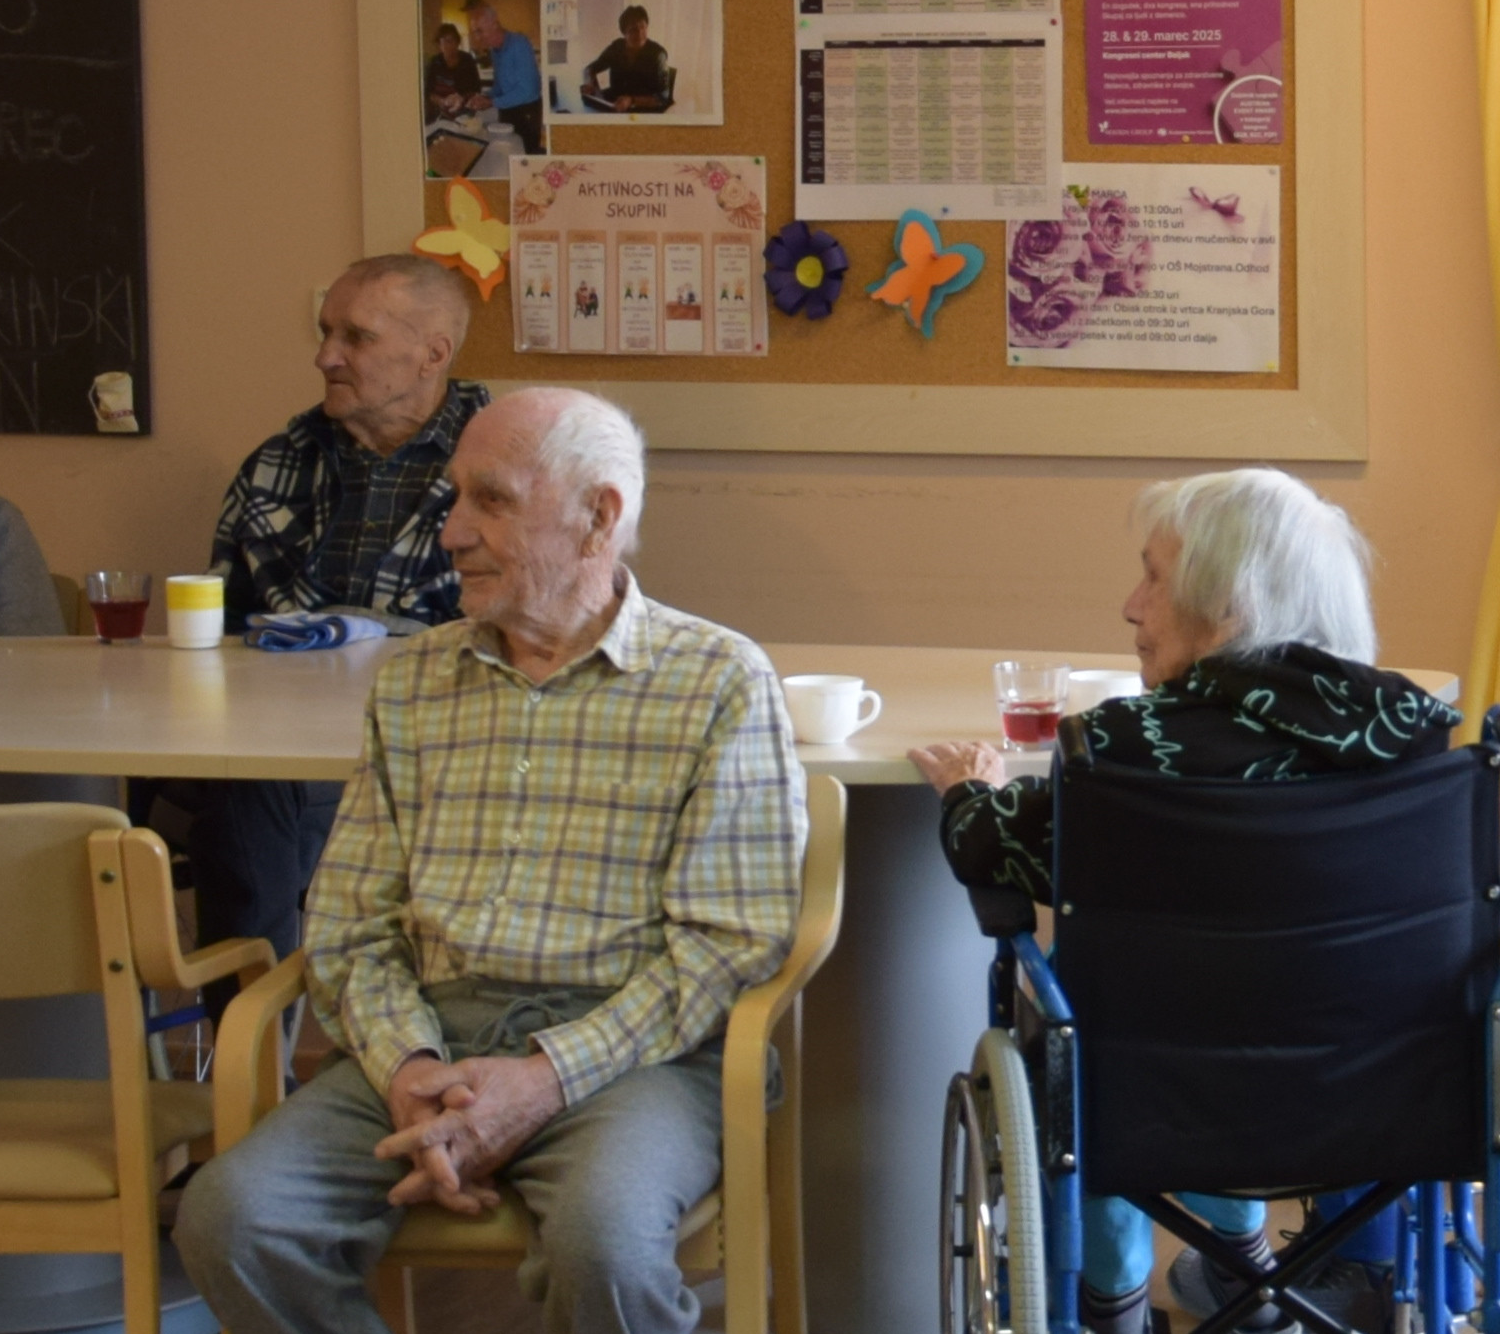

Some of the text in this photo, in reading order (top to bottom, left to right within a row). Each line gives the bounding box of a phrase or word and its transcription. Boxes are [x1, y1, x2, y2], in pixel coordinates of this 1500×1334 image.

[1102, 29, 1222, 43] 28. & 29. marec 2025
[577, 181, 695, 198] AKTIVNOSTI NA
[1091, 189, 1128, 199] MARCA
[605, 202, 667, 218] SKUPINI
[1143, 205, 1183, 215] 13:00uri
[1143, 219, 1169, 228] 10:15
[1171, 219, 1185, 229] uri
[1162, 234, 1193, 243] dnevu
[1195, 234, 1249, 244] mučenikov
[1167, 261, 1182, 271] OŠ
[1166, 290, 1180, 300] uri
[1113, 303, 1140, 313] Obisk
[1142, 305, 1167, 314] otrok
[1169, 305, 1178, 314] iz
[1179, 306, 1205, 314] vrtca
[1206, 305, 1249, 317] Kranjska
[1250, 306, 1275, 316] Gora
[1085, 318, 1131, 327] začetkom
[1133, 319, 1145, 327] ob
[1147, 318, 1175, 328] 09:30
[1177, 319, 1190, 328] uri
[1080, 332, 1107, 341] petek
[1116, 332, 1133, 341] avli
[1134, 332, 1147, 341] od
[1149, 332, 1176, 342] 09:00
[1178, 333, 1191, 342] uri
[1193, 333, 1217, 344] dalje
